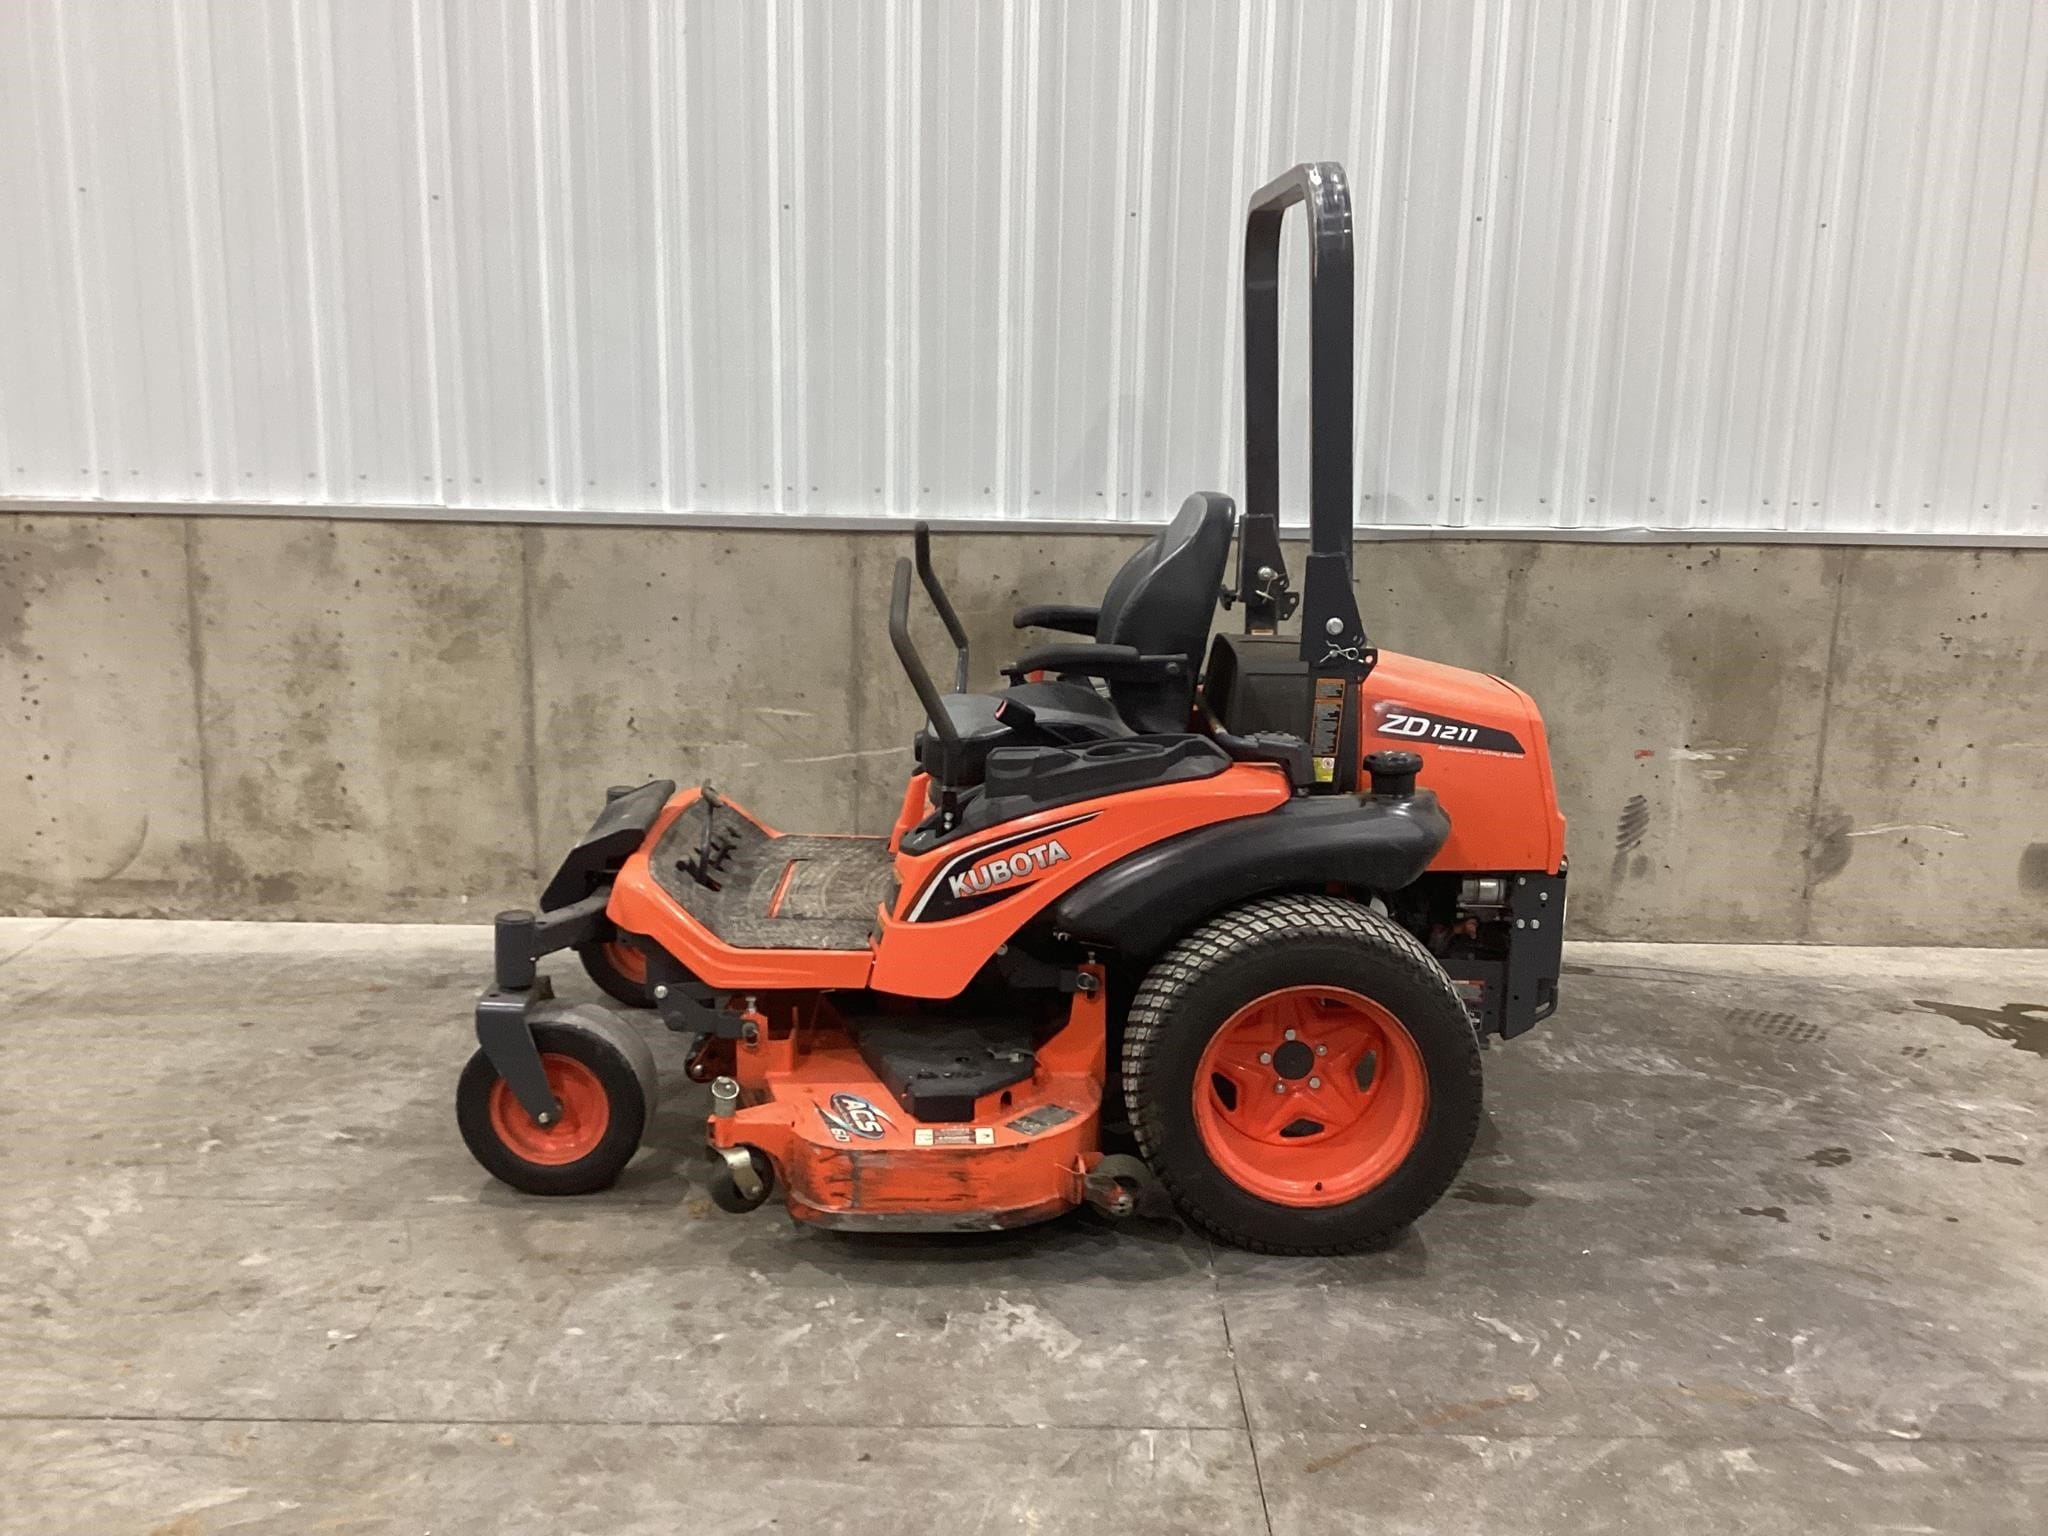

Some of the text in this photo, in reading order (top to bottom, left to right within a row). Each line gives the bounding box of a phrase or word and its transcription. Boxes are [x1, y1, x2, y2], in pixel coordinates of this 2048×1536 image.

[1378, 714, 1478, 742] ZD 1211
[948, 840, 1070, 899] KUBOTA
[841, 1099, 884, 1132] ACS
